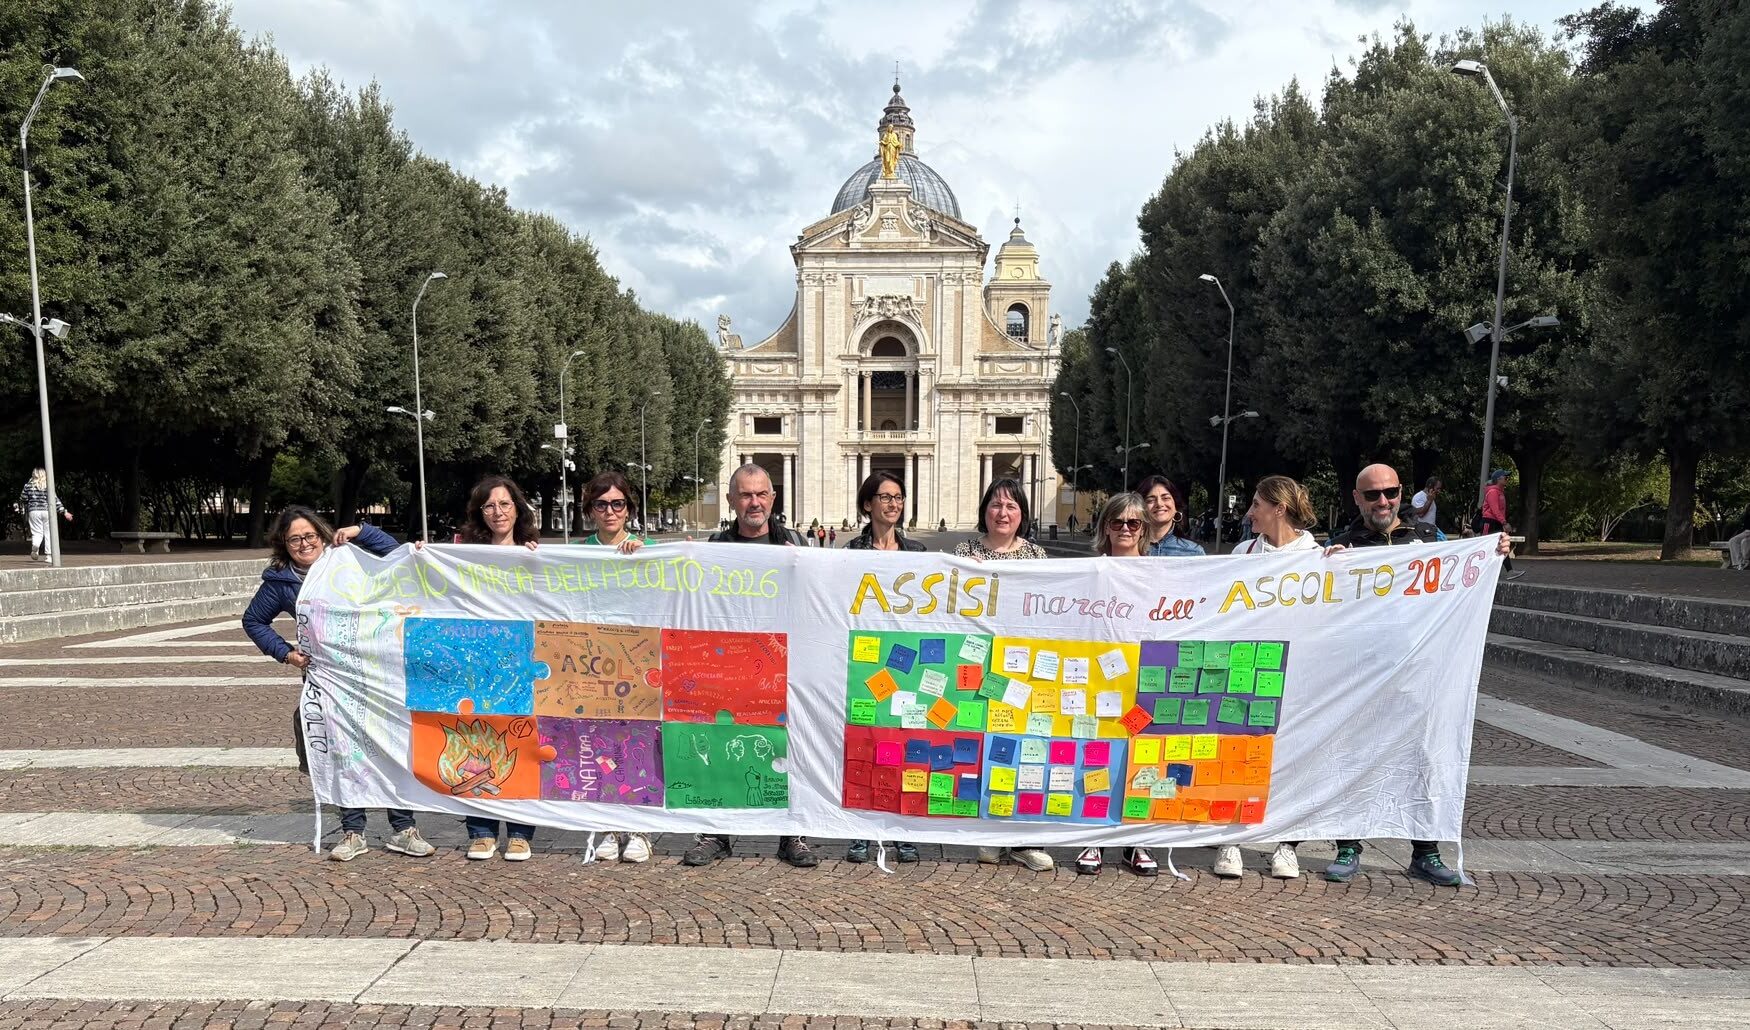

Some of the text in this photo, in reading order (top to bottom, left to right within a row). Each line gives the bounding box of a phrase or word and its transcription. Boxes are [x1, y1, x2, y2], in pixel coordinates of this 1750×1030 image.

[328, 561, 449, 606] GUBBIO
[709, 564, 779, 599] 2026
[1022, 592, 1135, 620] marcia
[1403, 549, 1487, 598] 2026
[579, 735, 599, 792] NATURA
